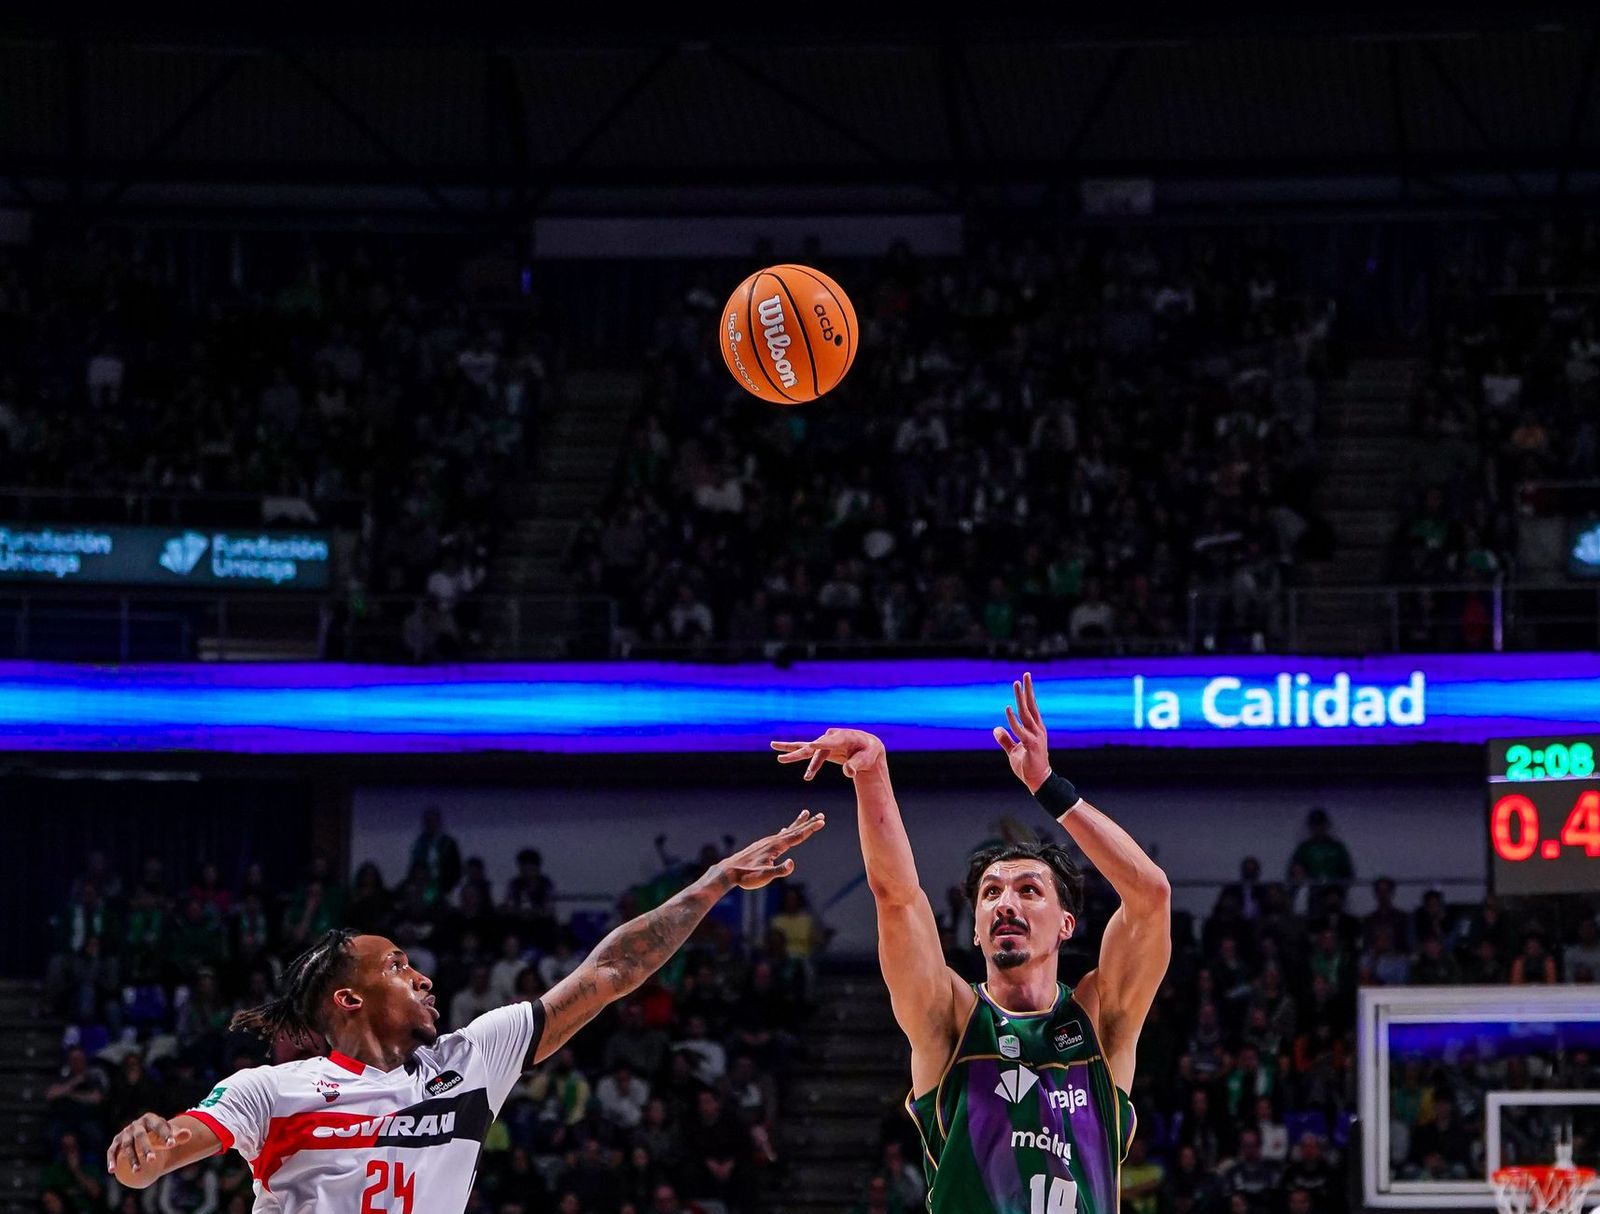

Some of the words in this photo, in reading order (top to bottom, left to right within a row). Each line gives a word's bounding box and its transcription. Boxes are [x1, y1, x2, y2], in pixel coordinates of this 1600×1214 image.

[757, 295, 798, 389] Wilson
[813, 304, 834, 342] acb
[1132, 674, 1180, 729] la
[1202, 670, 1426, 728] Calidad
[1505, 741, 1595, 781] 2:08
[1491, 789, 1600, 862] 0.4
